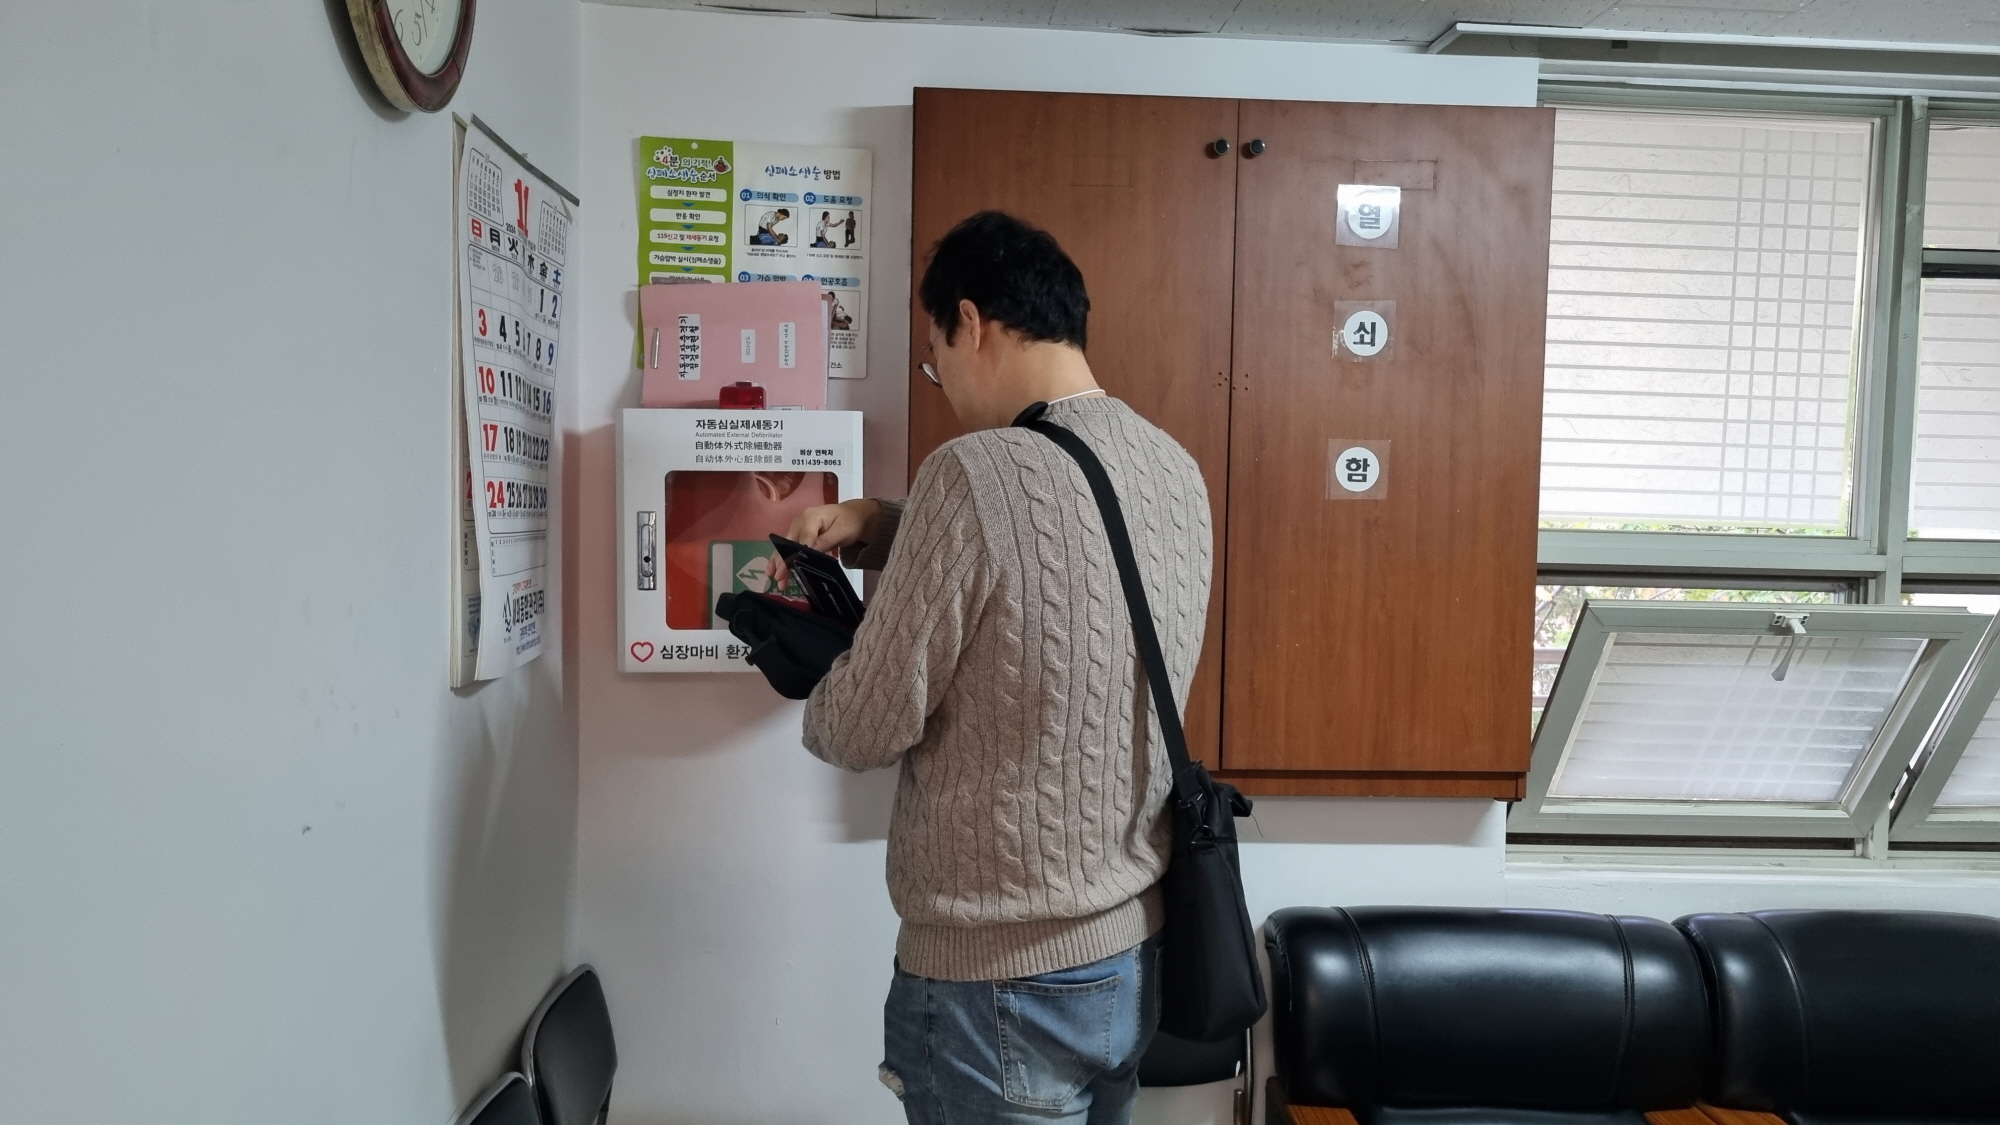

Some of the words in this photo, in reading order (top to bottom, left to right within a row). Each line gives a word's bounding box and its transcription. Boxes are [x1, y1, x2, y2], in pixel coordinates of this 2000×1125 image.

[647, 168, 698, 182] 심폐소생술
[700, 171, 716, 181] 순서
[765, 165, 821, 180] 심폐소생술
[824, 169, 840, 180] 방법
[514, 178, 529, 238] 11
[772, 193, 786, 201] 확인
[1358, 203, 1381, 230] 열
[472, 218, 482, 238] 日
[490, 228, 501, 247] 月
[508, 236, 519, 255] 火
[539, 262, 548, 279] 金
[552, 268, 561, 285] 土
[821, 278, 848, 286] 인공호흡
[540, 288, 544, 313] 1
[552, 294, 558, 318] 2
[478, 308, 487, 337] 3
[499, 315, 507, 343] 4
[515, 320, 520, 347] 5
[536, 337, 541, 361] 8
[548, 342, 554, 366] 9
[679, 316, 690, 378] 자동심장충격기
[1353, 321, 1376, 347] 쇠
[479, 366, 495, 394] 10
[500, 370, 512, 399] 11
[533, 387, 540, 412] 15
[543, 390, 551, 415] 16
[696, 419, 783, 430] 자동심실제세동기
[483, 424, 499, 452] 17
[504, 426, 514, 453] 18
[540, 438, 548, 462] 23
[696, 441, 782, 450] 自動体外式除細動器
[1345, 457, 1370, 483] 함
[487, 481, 505, 509] 24
[507, 481, 515, 508] 25
[540, 486, 547, 509] 30
[660, 644, 718, 659] 심장마비
